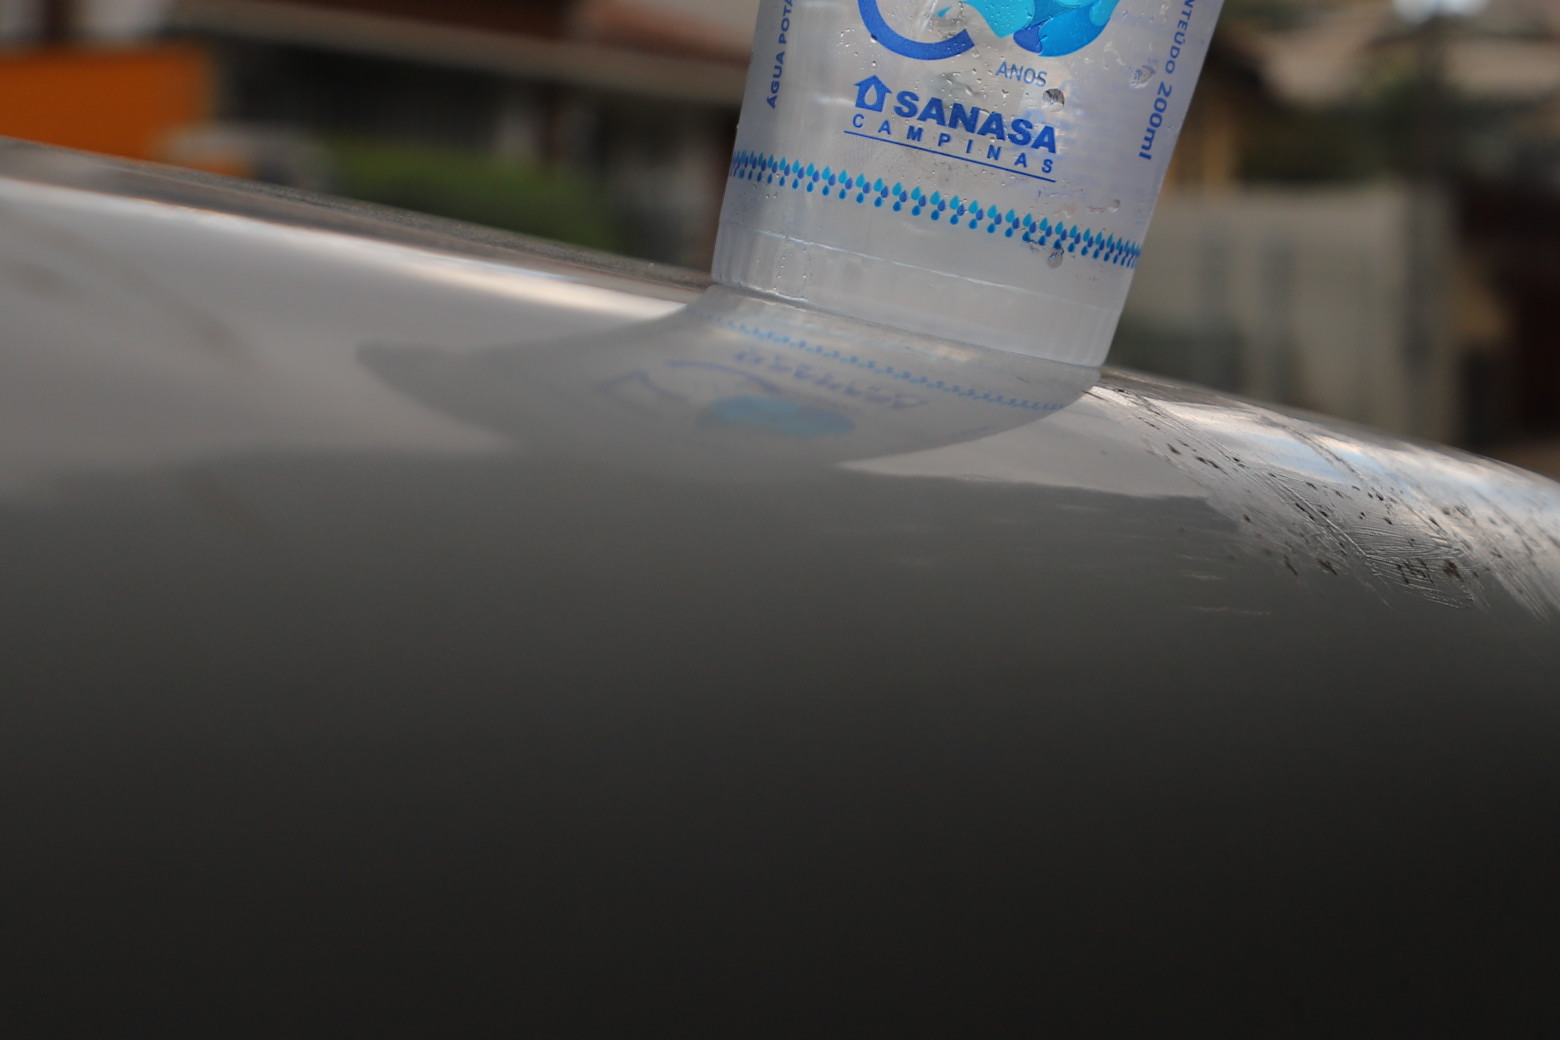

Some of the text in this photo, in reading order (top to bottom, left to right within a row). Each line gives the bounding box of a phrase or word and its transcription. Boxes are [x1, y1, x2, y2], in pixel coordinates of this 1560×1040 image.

[766, 51, 786, 109] ÁGUA
[995, 60, 1048, 88] ANOS
[852, 113, 1054, 174] CAMPINAS
[893, 90, 1057, 154] SANASA
